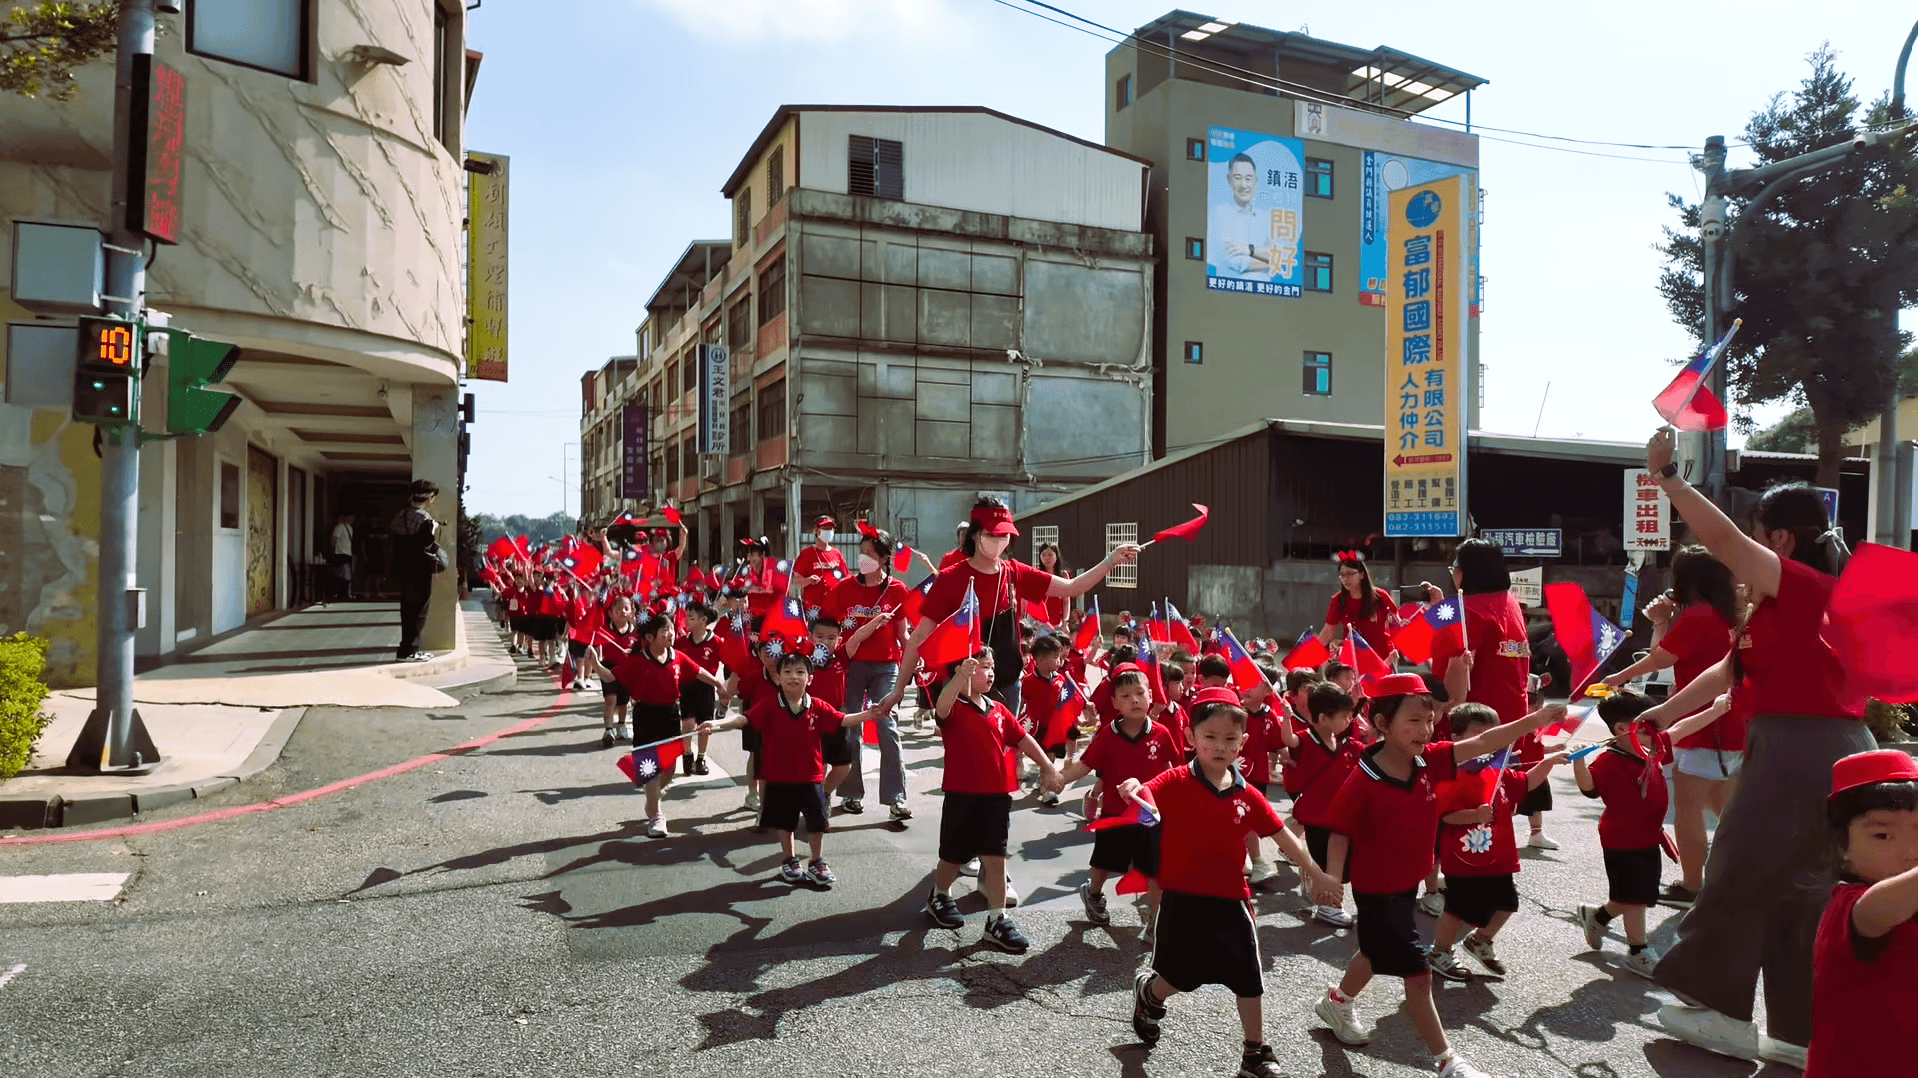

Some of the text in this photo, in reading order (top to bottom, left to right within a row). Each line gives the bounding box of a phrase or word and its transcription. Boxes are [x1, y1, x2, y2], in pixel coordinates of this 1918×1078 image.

[1267, 169, 1298, 190] 鎮浯
[1270, 208, 1298, 278] 問好
[1257, 281, 1300, 297] 更好的金門
[1403, 234, 1431, 366] 富郁國際
[101, 327, 130, 364] 10
[1400, 371, 1419, 451] 人力仲介
[1424, 368, 1445, 448] 有限公司
